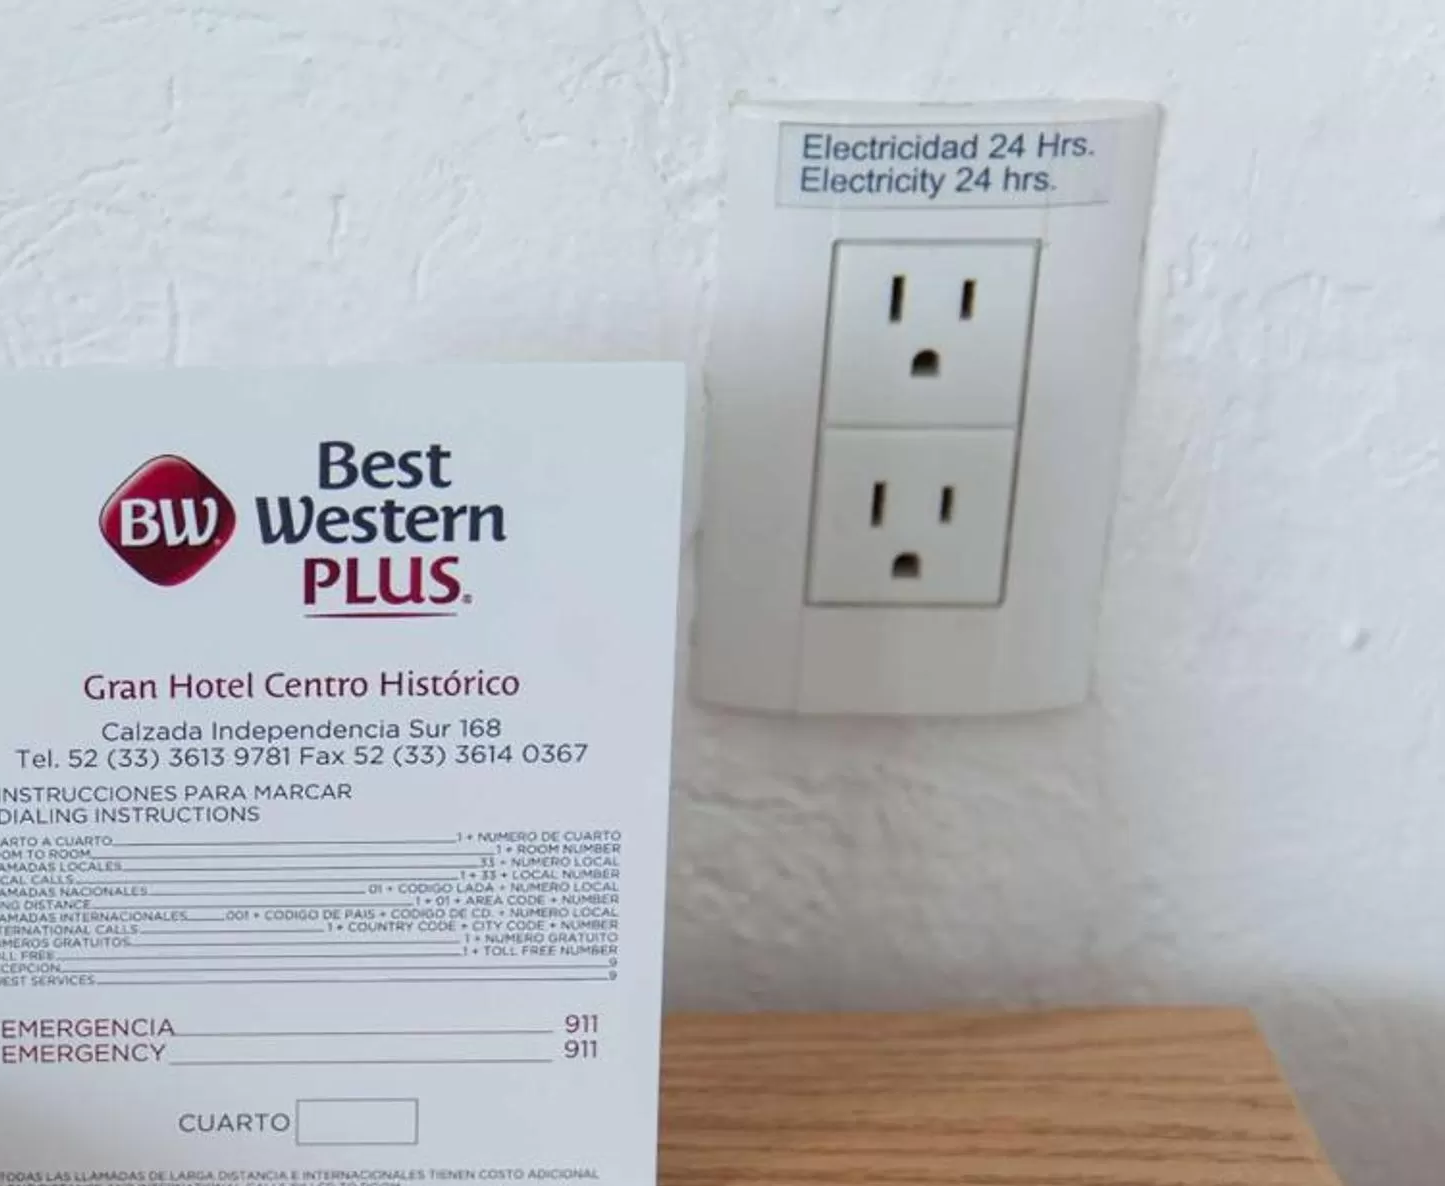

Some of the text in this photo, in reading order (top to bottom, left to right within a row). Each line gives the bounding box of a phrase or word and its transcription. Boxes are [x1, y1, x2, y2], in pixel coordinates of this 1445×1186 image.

[802, 131, 1095, 161] Electricidad 24 Hrs.
[800, 165, 1057, 200] Electricity 24 hrs.
[318, 440, 452, 490] Best
[120, 498, 219, 548] BW
[255, 495, 507, 545] Western
[303, 556, 462, 606] PLUS
[83, 669, 520, 701] Gran Hotel Centro Histórico
[101, 717, 502, 744] Calzada Independencia Sur 168
[15, 742, 589, 771] Tel. 52 (33) 3613 9781 Fax 52 (33) 3614 0367
[184, 784, 247, 802] PARA
[254, 783, 352, 801] MARCAR
[94, 805, 261, 824] INSTRUCTIONS
[42, 836, 52, 847] A
[56, 836, 113, 846] CUARTO
[478, 831, 537, 842] NUMERO
[541, 831, 560, 841] DE
[564, 830, 622, 841] CUARTO
[28, 849, 45, 860] TO
[49, 849, 90, 859] ROOM
[517, 844, 559, 854] ROOM
[562, 843, 621, 853] NUMBER
[59, 861, 122, 872] LOCALES
[481, 857, 495, 868] 33
[511, 857, 571, 867] NUMERO
[574, 856, 620, 867] LOCAL
[31, 874, 74, 885] CALLS
[482, 870, 496, 880] 33
[512, 870, 557, 880] LOCAL
[562, 869, 620, 880] NUMBER
[59, 886, 148, 897] NACIONALES
[368, 884, 383, 894] 01
[398, 883, 454, 894] CODIGO
[457, 882, 494, 893] LADA
[510, 882, 570, 892] NUMERO
[573, 881, 619, 892] LOCAL
[23, 899, 90, 910] DISTANCE
[435, 896, 450, 906] 01
[466, 895, 504, 906] AREA
[507, 895, 545, 905] CODE
[562, 894, 619, 904] NUMBER
[59, 911, 188, 922] INTERNACIONALES
[225, 910, 249, 921] 001
[264, 909, 319, 921] CODIGO
[323, 909, 341, 920] DE
[344, 909, 375, 920] PAIS
[390, 908, 446, 919] CODIGO
[449, 908, 467, 918] DE
[510, 907, 569, 918] NUMERO
[572, 907, 618, 917] LOCAL
[95, 924, 139, 935] CALLS
[348, 922, 413, 933] COUNTRY
[417, 921, 455, 932] CODE
[472, 920, 503, 931] CITY
[506, 920, 544, 931] CODE
[561, 920, 618, 930] NUMBER
[53, 937, 132, 948] GRATUITOS
[485, 933, 544, 943] NUMERO
[548, 932, 619, 943] GRATUITO
[21, 951, 55, 961] FREE
[484, 945, 518, 956] TOLL
[522, 945, 557, 956] FREE
[560, 945, 618, 956] NUMBER
[31, 975, 96, 986] SERVICES
[1, 1014, 598, 1040] EMERGENCIA 911
[1, 1039, 597, 1065] EMERGENCY 911
[178, 1112, 291, 1134] CUARTO
[0, 1171, 43, 1182] TODAS
[46, 1171, 70, 1182] LAS
[74, 1170, 145, 1182] LLAMADAS
[148, 1170, 163, 1181] DE
[169, 1170, 213, 1181] LARGA
[218, 1170, 288, 1181] DISTANCIA
[304, 1169, 425, 1181] INTERNACIONALES
[430, 1169, 475, 1180] TIENEN
[479, 1168, 524, 1179] COSTO
[528, 1168, 600, 1179] ADICIONAL
